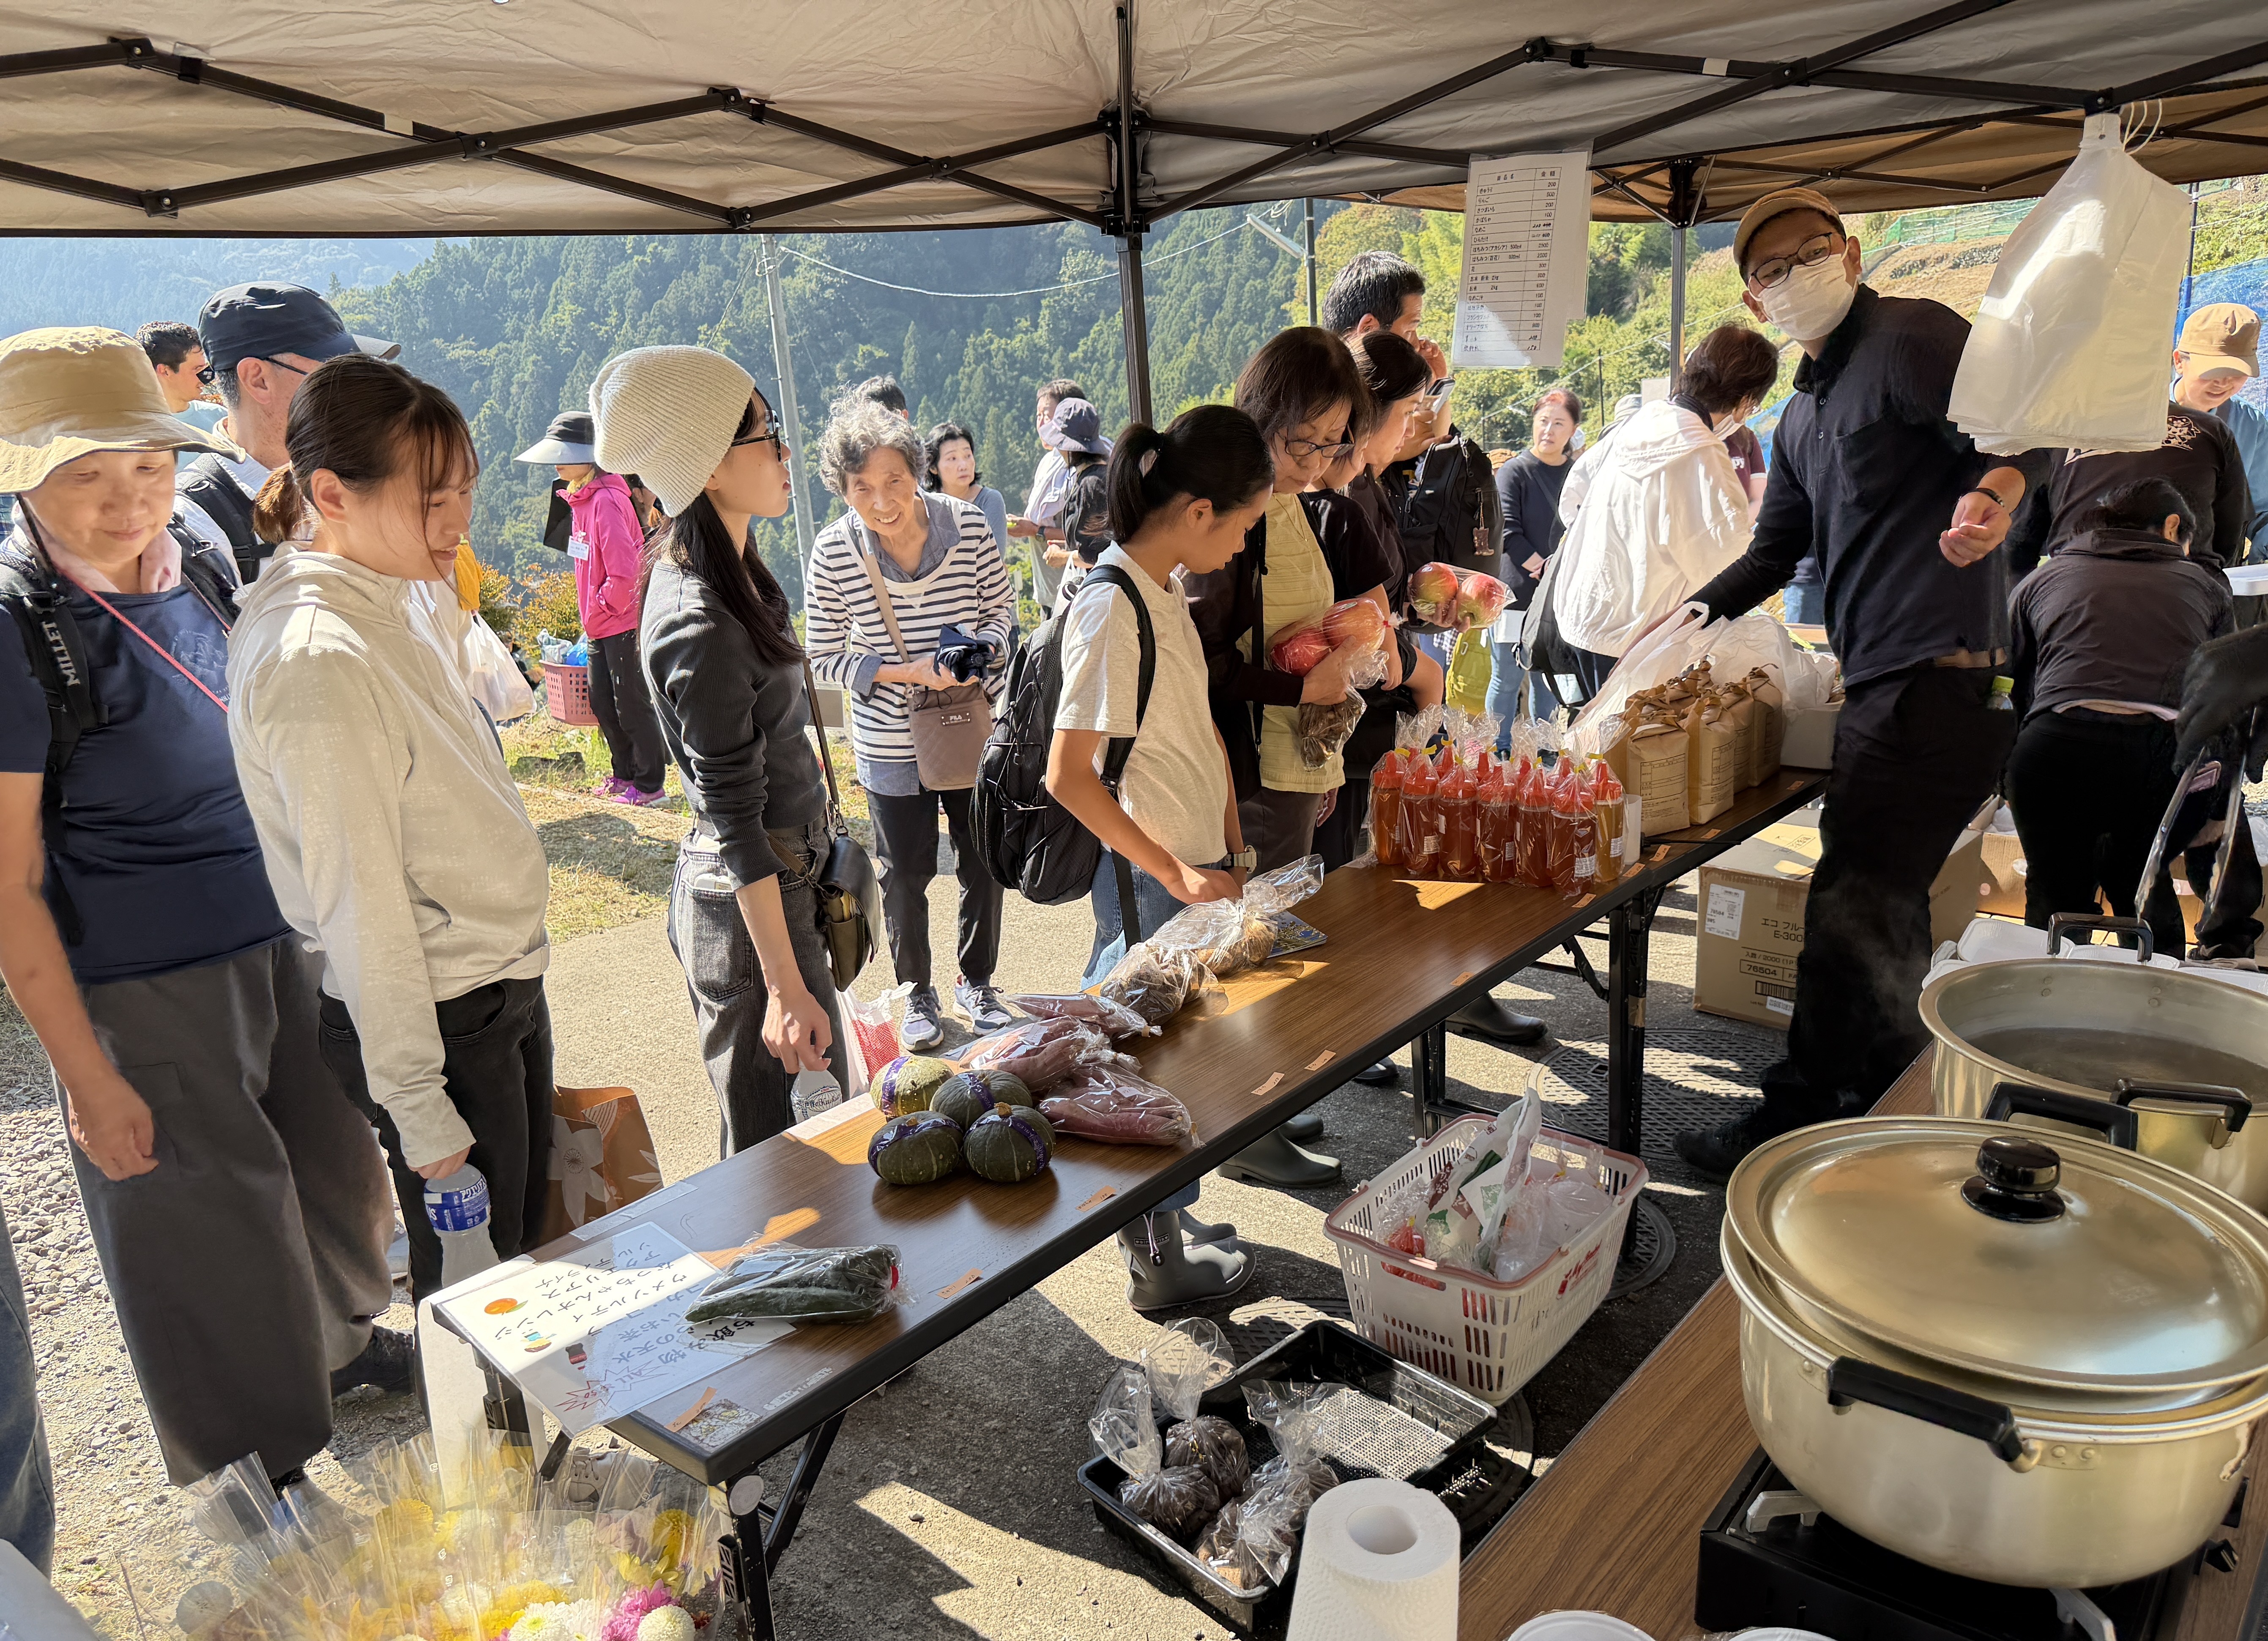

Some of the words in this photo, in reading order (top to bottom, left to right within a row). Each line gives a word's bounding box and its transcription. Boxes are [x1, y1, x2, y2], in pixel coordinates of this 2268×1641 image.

[42, 621, 81, 686] MILLET
[1761, 918, 1778, 927] エコ
[1763, 954, 1780, 963] 2000
[1747, 964, 1777, 976] 76504
[542, 1251, 660, 1299] アクエリアス
[495, 1261, 673, 1340] なっちゃんオレンジ
[615, 1369, 646, 1383] ALL
